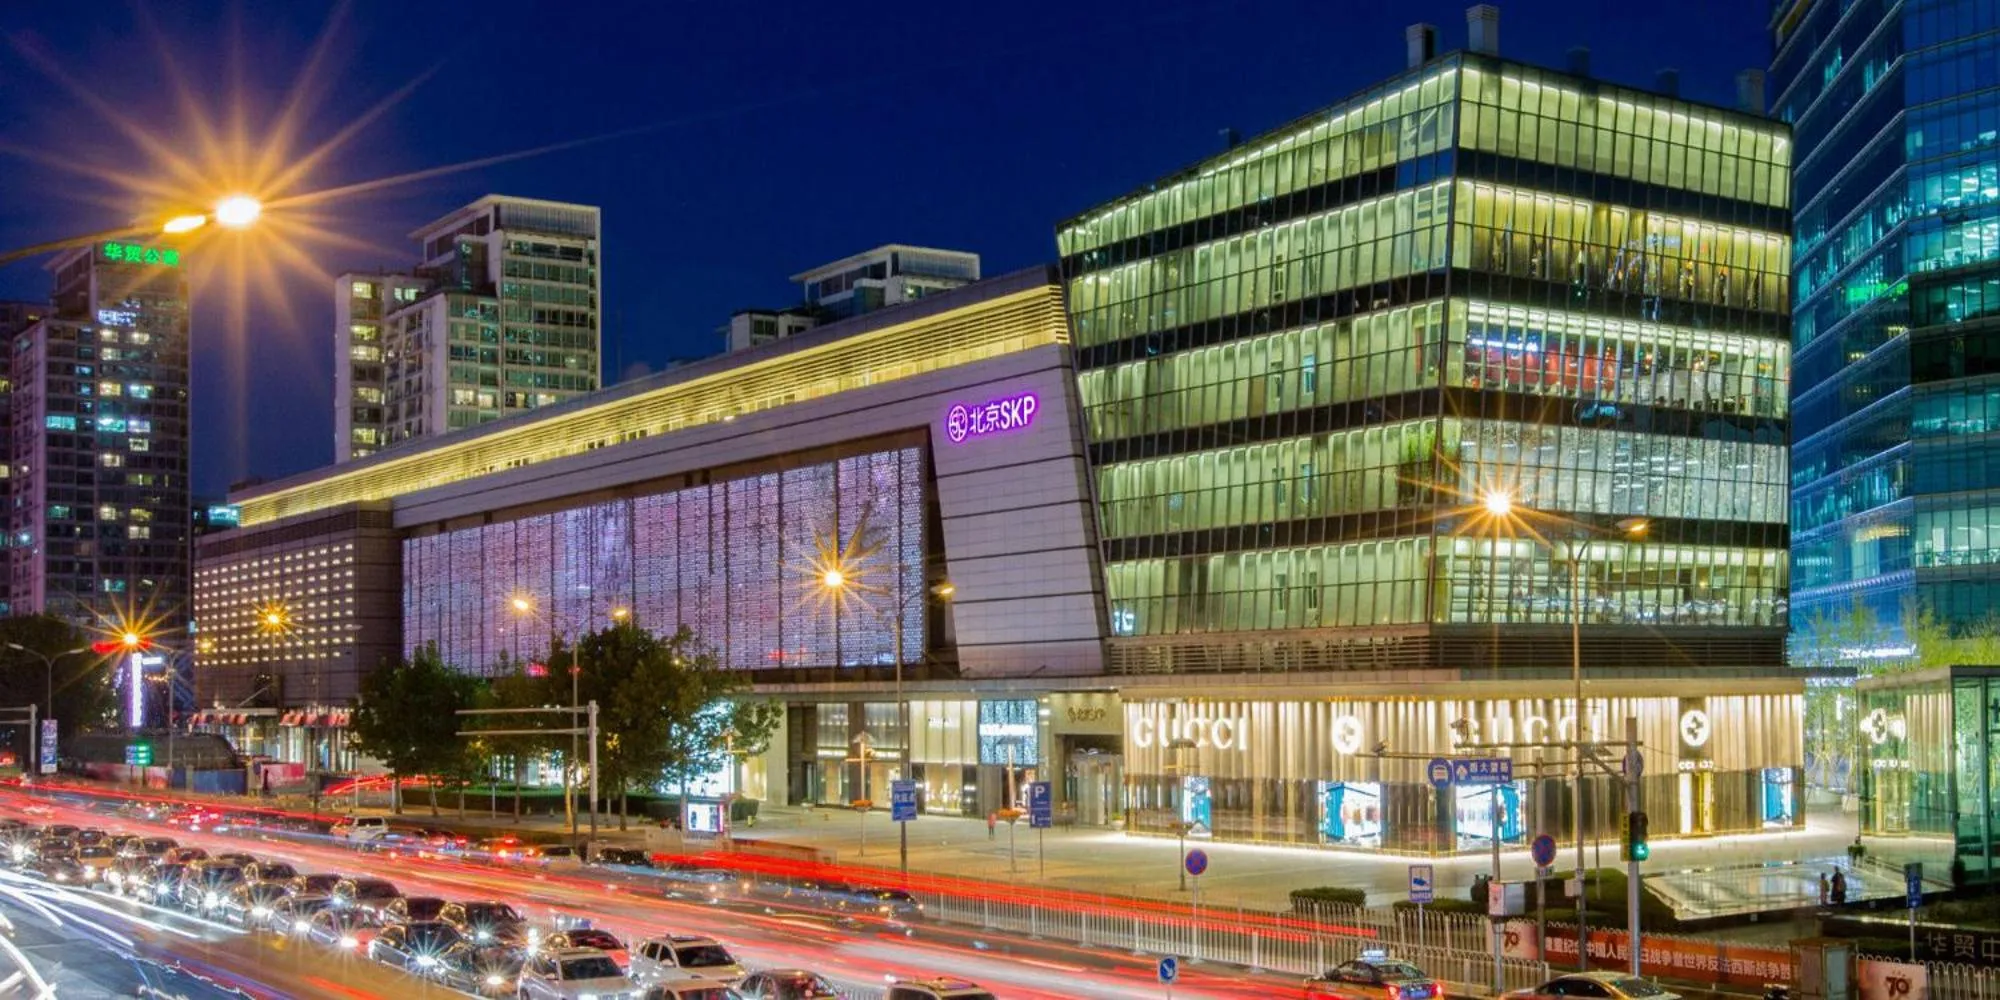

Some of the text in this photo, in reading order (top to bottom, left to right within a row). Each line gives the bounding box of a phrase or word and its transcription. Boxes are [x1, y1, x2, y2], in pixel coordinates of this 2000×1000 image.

[969, 395, 1036, 434] 北京SKP
[1133, 717, 1247, 751] GUCCI
[1451, 716, 1601, 749] GUCCI
[1035, 785, 1045, 798] P
[1885, 976, 1910, 997] 70
